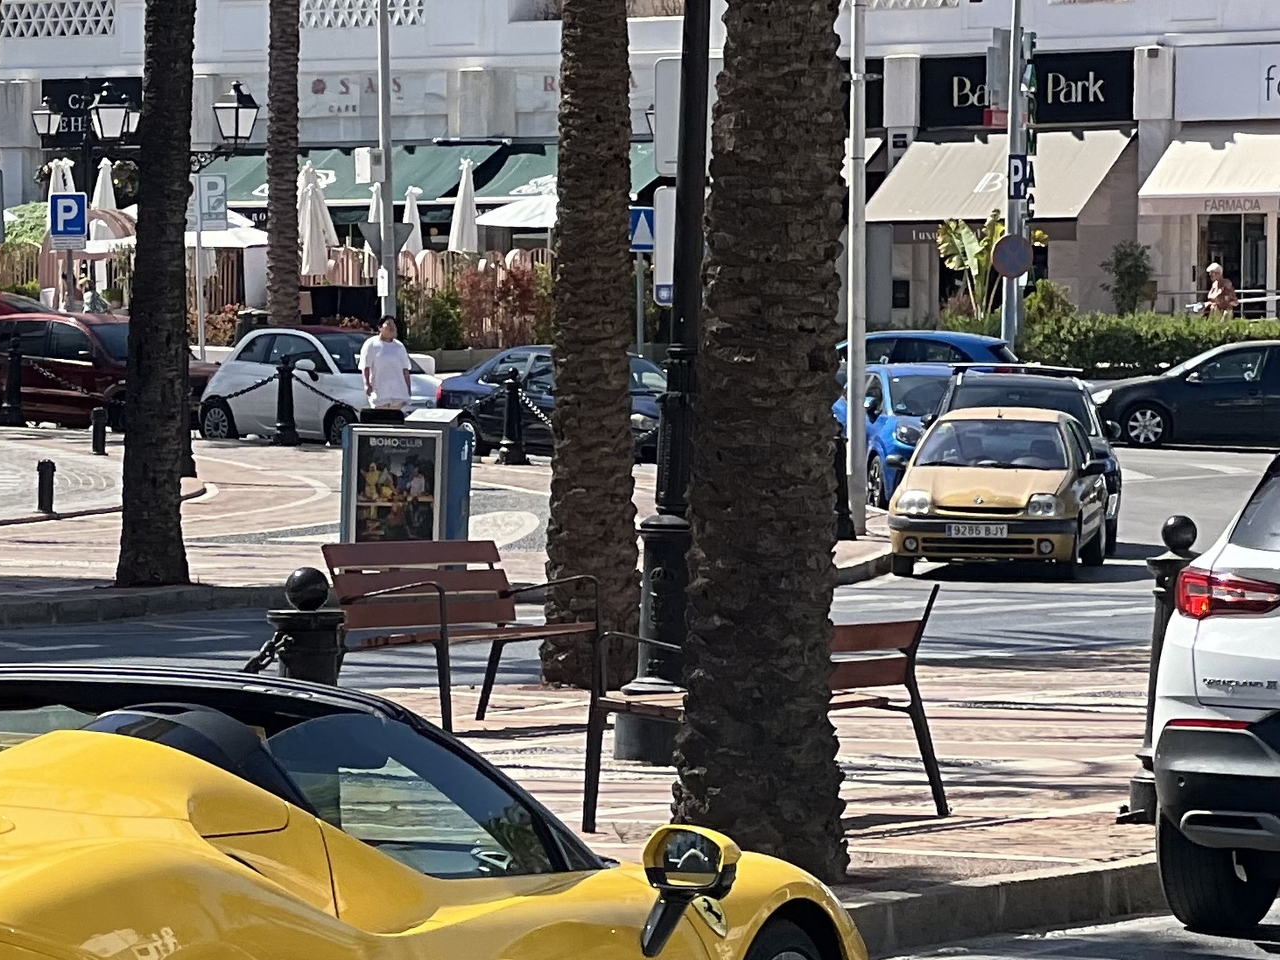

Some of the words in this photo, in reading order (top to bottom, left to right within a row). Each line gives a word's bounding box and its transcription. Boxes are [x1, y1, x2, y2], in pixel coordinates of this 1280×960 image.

[952, 76, 989, 107] Ba
[1047, 71, 1105, 104] Park
[1265, 65, 1280, 101] f
[57, 198, 78, 231] P
[1204, 199, 1261, 212] FARMACIA
